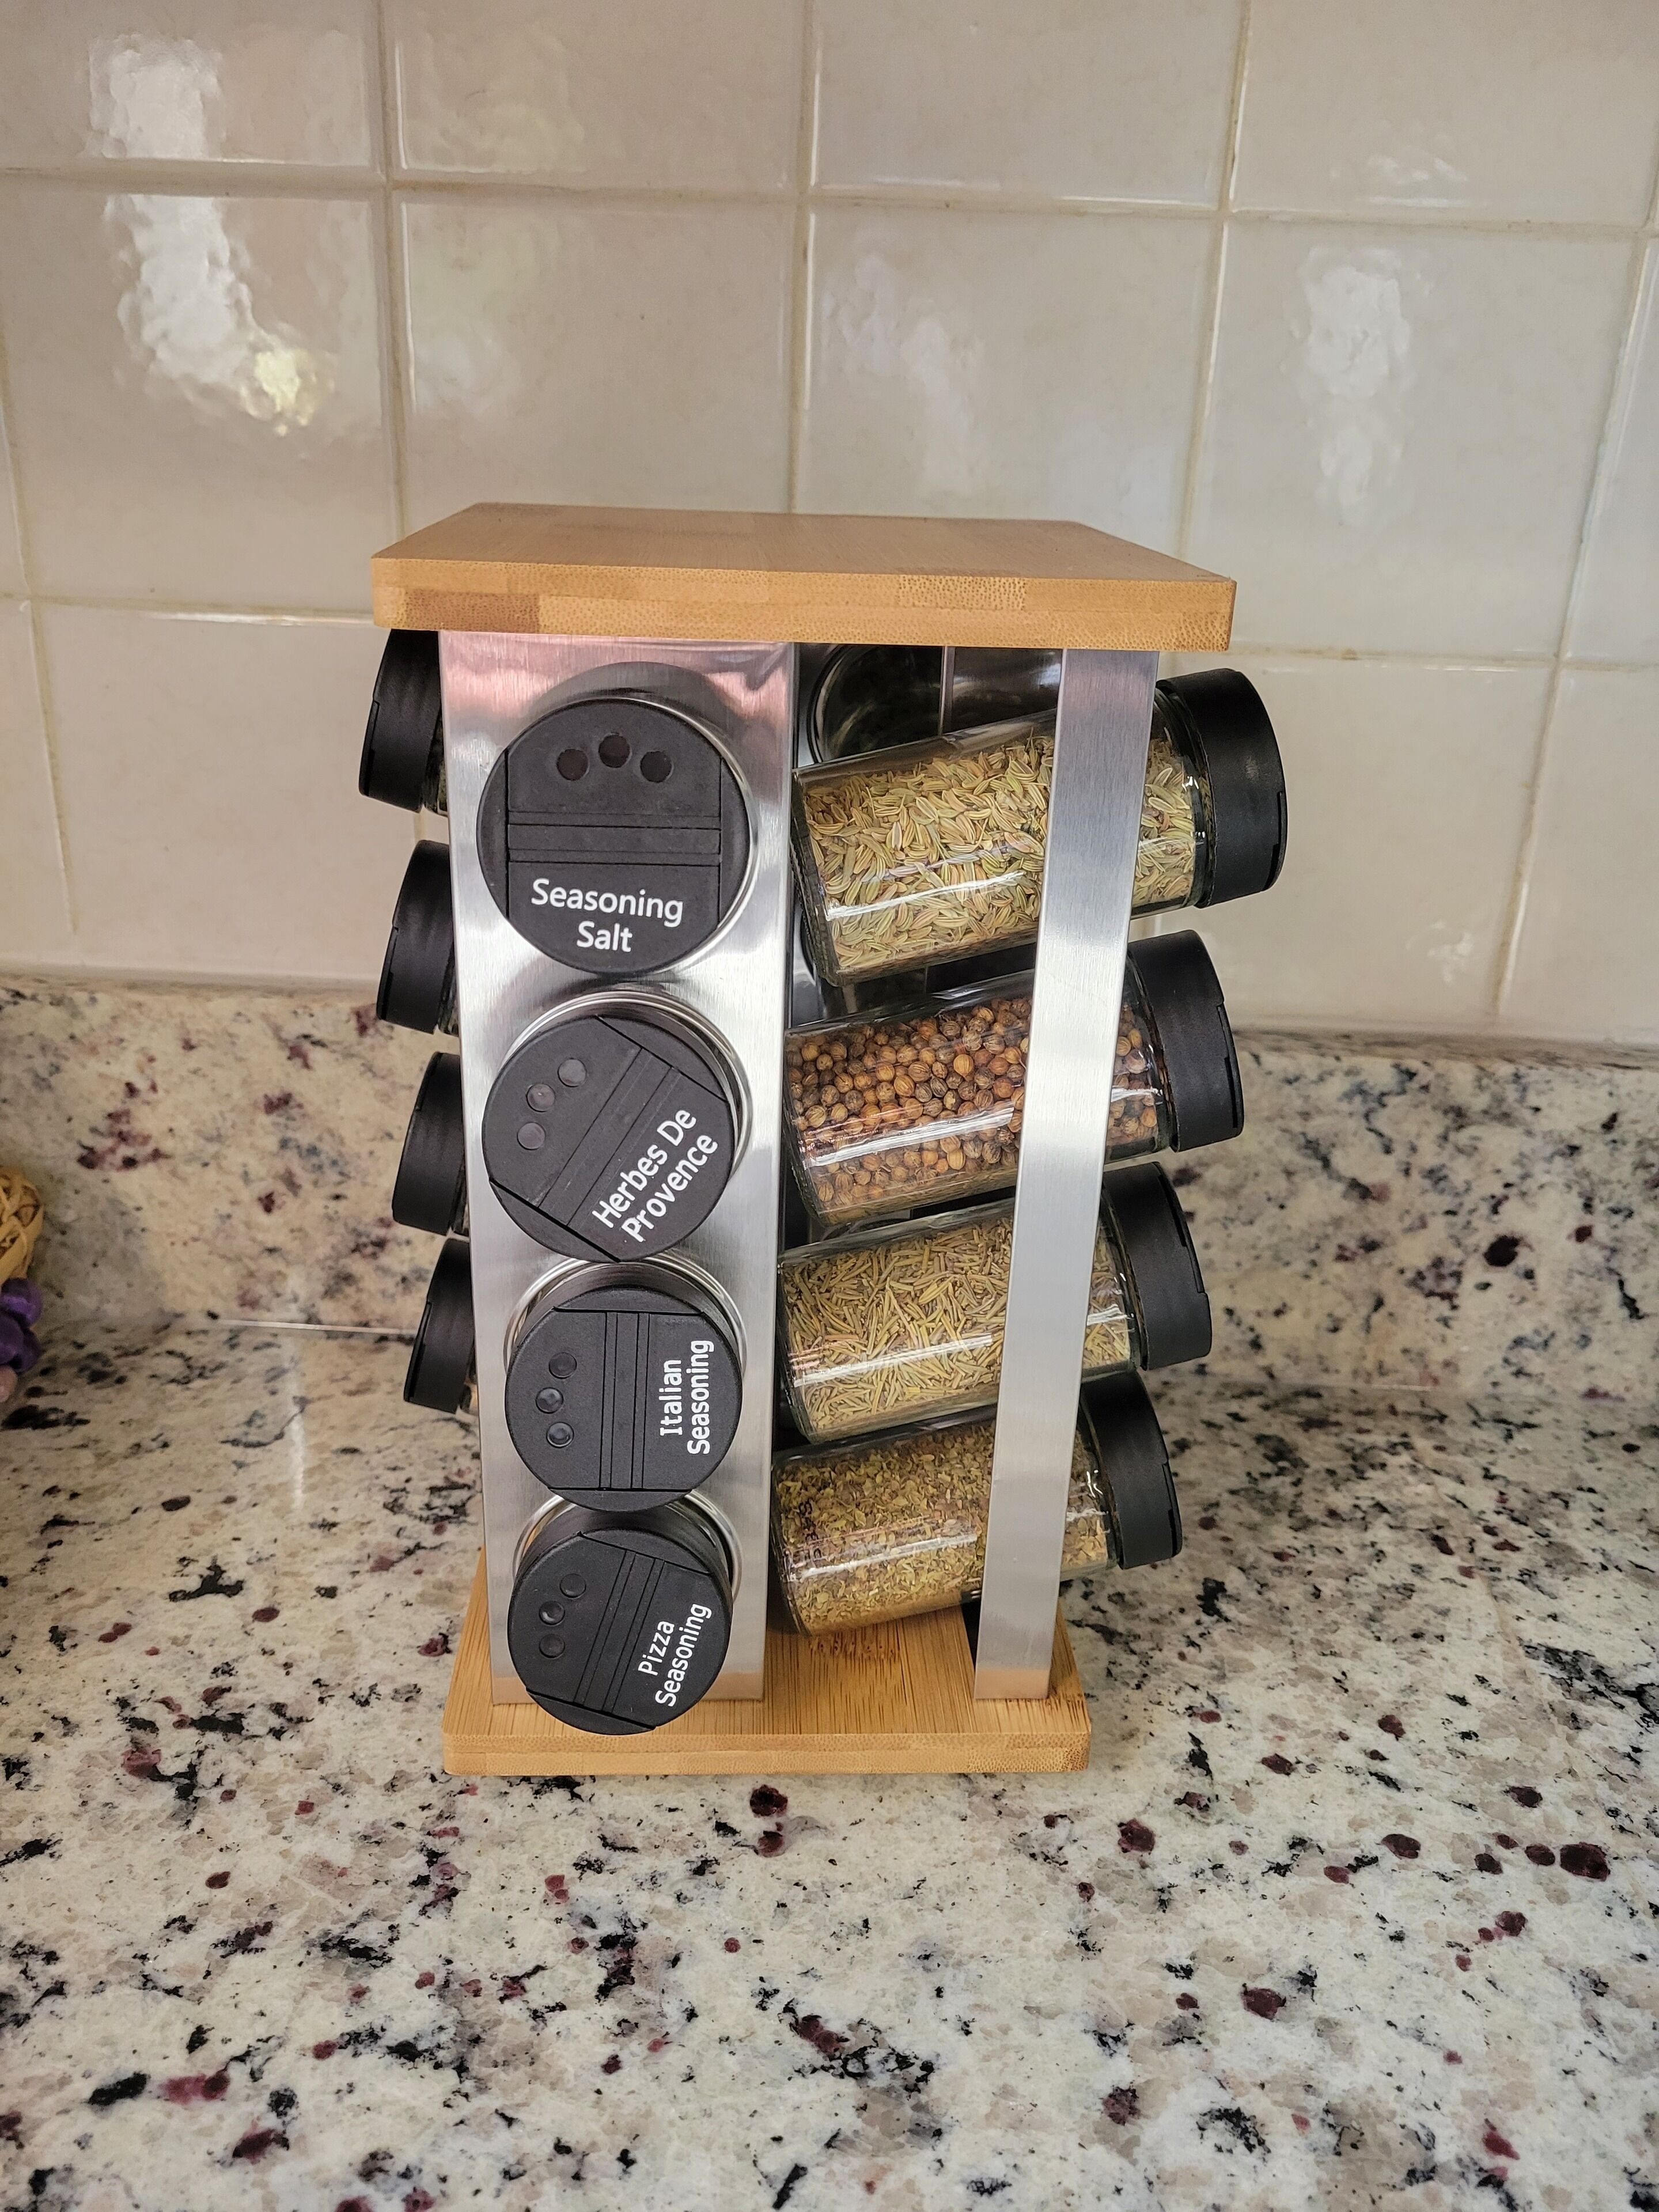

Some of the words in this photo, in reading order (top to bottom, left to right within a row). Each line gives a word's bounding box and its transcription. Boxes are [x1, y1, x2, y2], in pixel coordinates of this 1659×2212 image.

[531, 878, 683, 928] Seasoning
[576, 921, 633, 952] Salt
[592, 1144, 668, 1228] Herbes
[656, 1109, 697, 1146] De
[621, 1135, 718, 1243] Provence
[658, 1359, 683, 1436] Italian
[685, 1340, 714, 1455] Seasoning
[638, 1621, 675, 1676] Pizza
[655, 1604, 712, 1707] Seasoning
